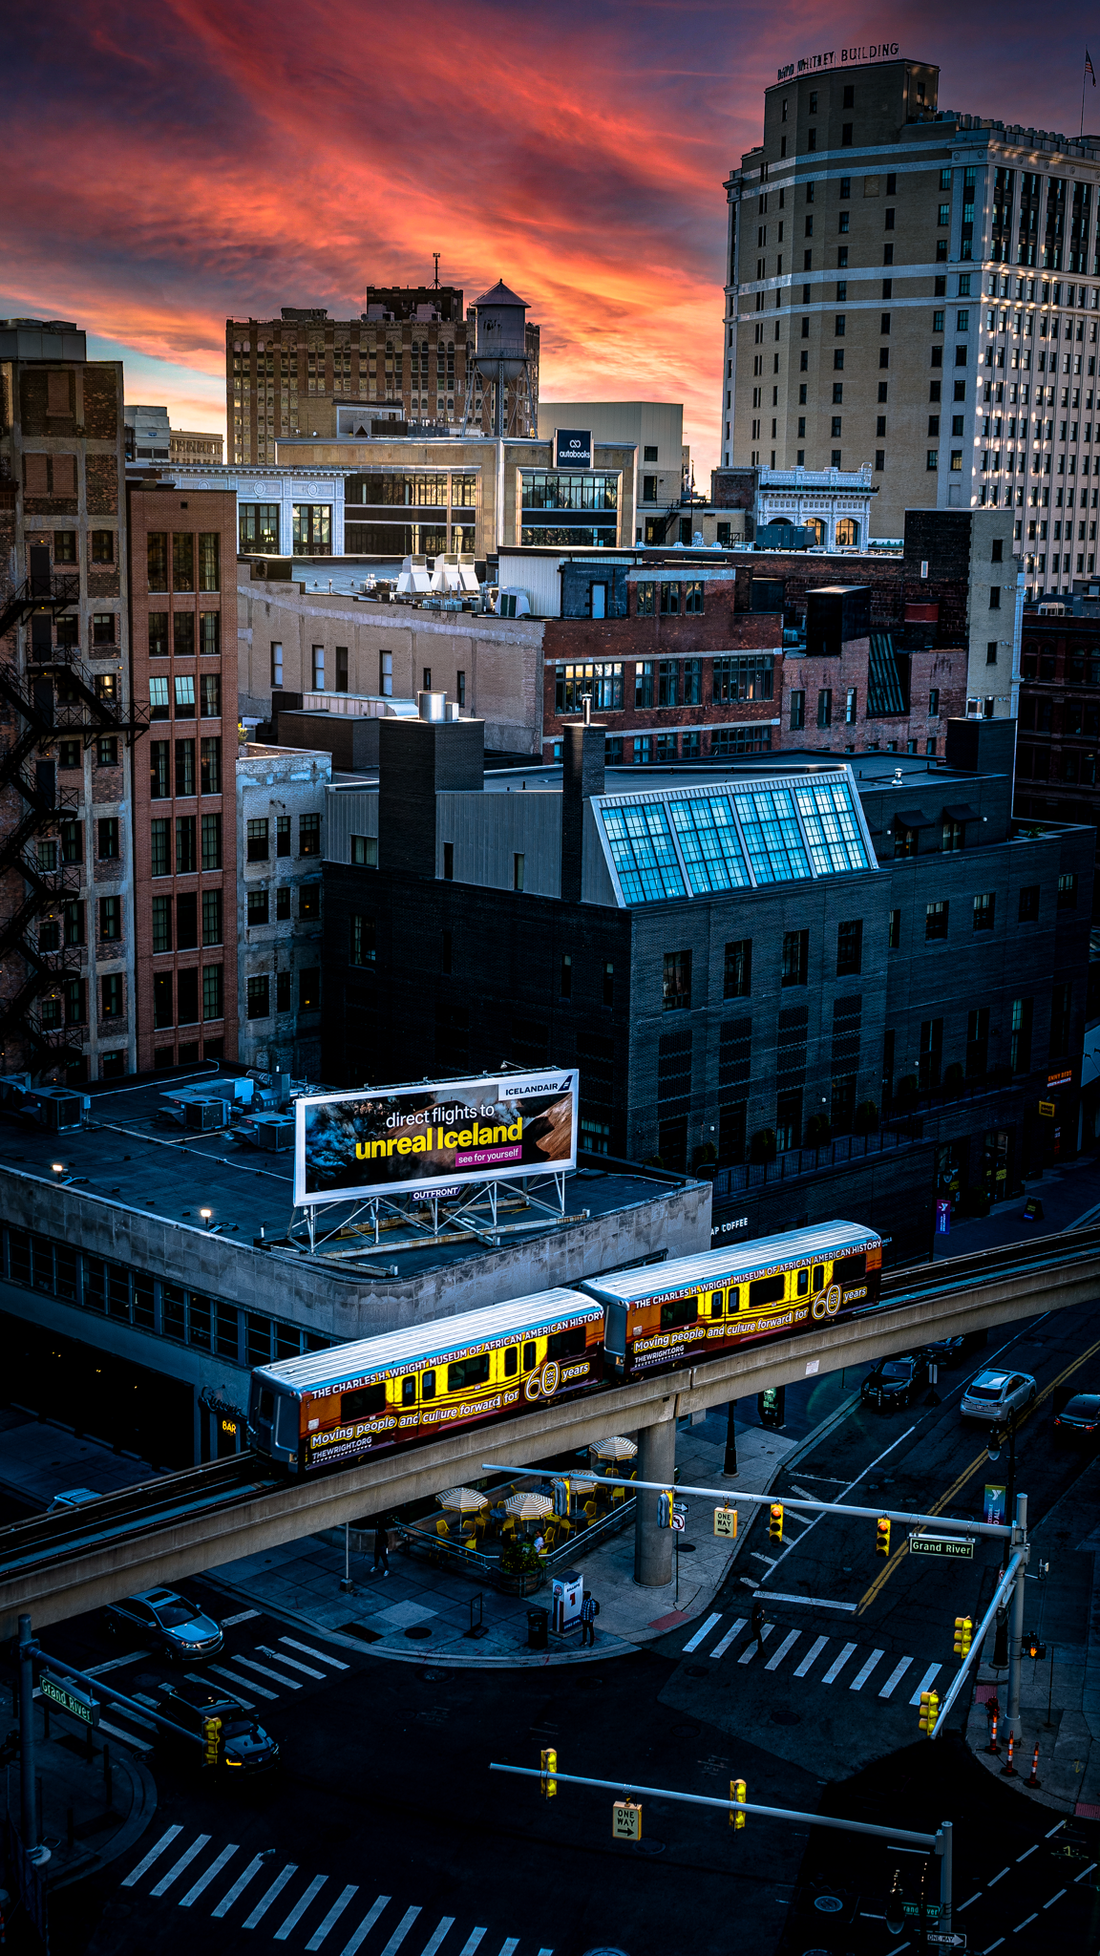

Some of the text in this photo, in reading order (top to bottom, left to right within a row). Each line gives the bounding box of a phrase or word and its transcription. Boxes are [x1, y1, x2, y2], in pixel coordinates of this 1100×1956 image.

[797, 51, 835, 72] WHITNEY
[841, 42, 899, 62] BUILDING
[559, 450, 590, 458] autobooks
[505, 1082, 558, 1096] ICELANDAIR
[386, 1104, 495, 1128] direct flights to
[355, 1117, 523, 1160] unreal Iceland
[458, 1148, 519, 1164] see for yourself
[413, 1186, 459, 1200] OUTFRONT
[721, 1217, 749, 1232] COFFEE
[635, 1298, 651, 1309] THE
[652, 1288, 689, 1304] CHARLES
[690, 1285, 699, 1294] H.
[700, 1277, 733, 1292] WRIGHT
[733, 1269, 766, 1285] MUSEUM
[766, 1266, 778, 1275] OF
[779, 1258, 812, 1272] AFRICAN
[813, 1247, 851, 1263] AMERICAN
[852, 1240, 881, 1254] HISTORY
[634, 1334, 669, 1352] Moving
[671, 1327, 704, 1344] people
[707, 1325, 725, 1337] and
[757, 1312, 792, 1329] forward
[794, 1308, 808, 1320] for
[813, 1285, 841, 1319] 60
[843, 1287, 867, 1303] years
[311, 1310, 604, 1400] THE CHARLES H. WRIGHT MUSEUM OF AFRICAN AMERICAN HISTORY
[634, 1345, 684, 1364] THEWRIGHT.ORG
[311, 1427, 354, 1448] Moving
[356, 1416, 396, 1436] people
[400, 1411, 421, 1426] and
[459, 1396, 501, 1416] forward
[504, 1389, 519, 1403] for
[526, 1362, 559, 1400] 60
[561, 1363, 589, 1381] years
[222, 1420, 236, 1435] BAR
[312, 1435, 373, 1460] THEWRIGHT.ORG
[717, 1512, 731, 1520] ONE
[717, 1519, 731, 1527] WAY
[912, 1541, 971, 1554] Grand River
[41, 1679, 90, 1720] Grand River
[617, 1809, 634, 1819] ONE
[617, 1817, 635, 1827] WAY
[903, 1905, 919, 1914] rand
